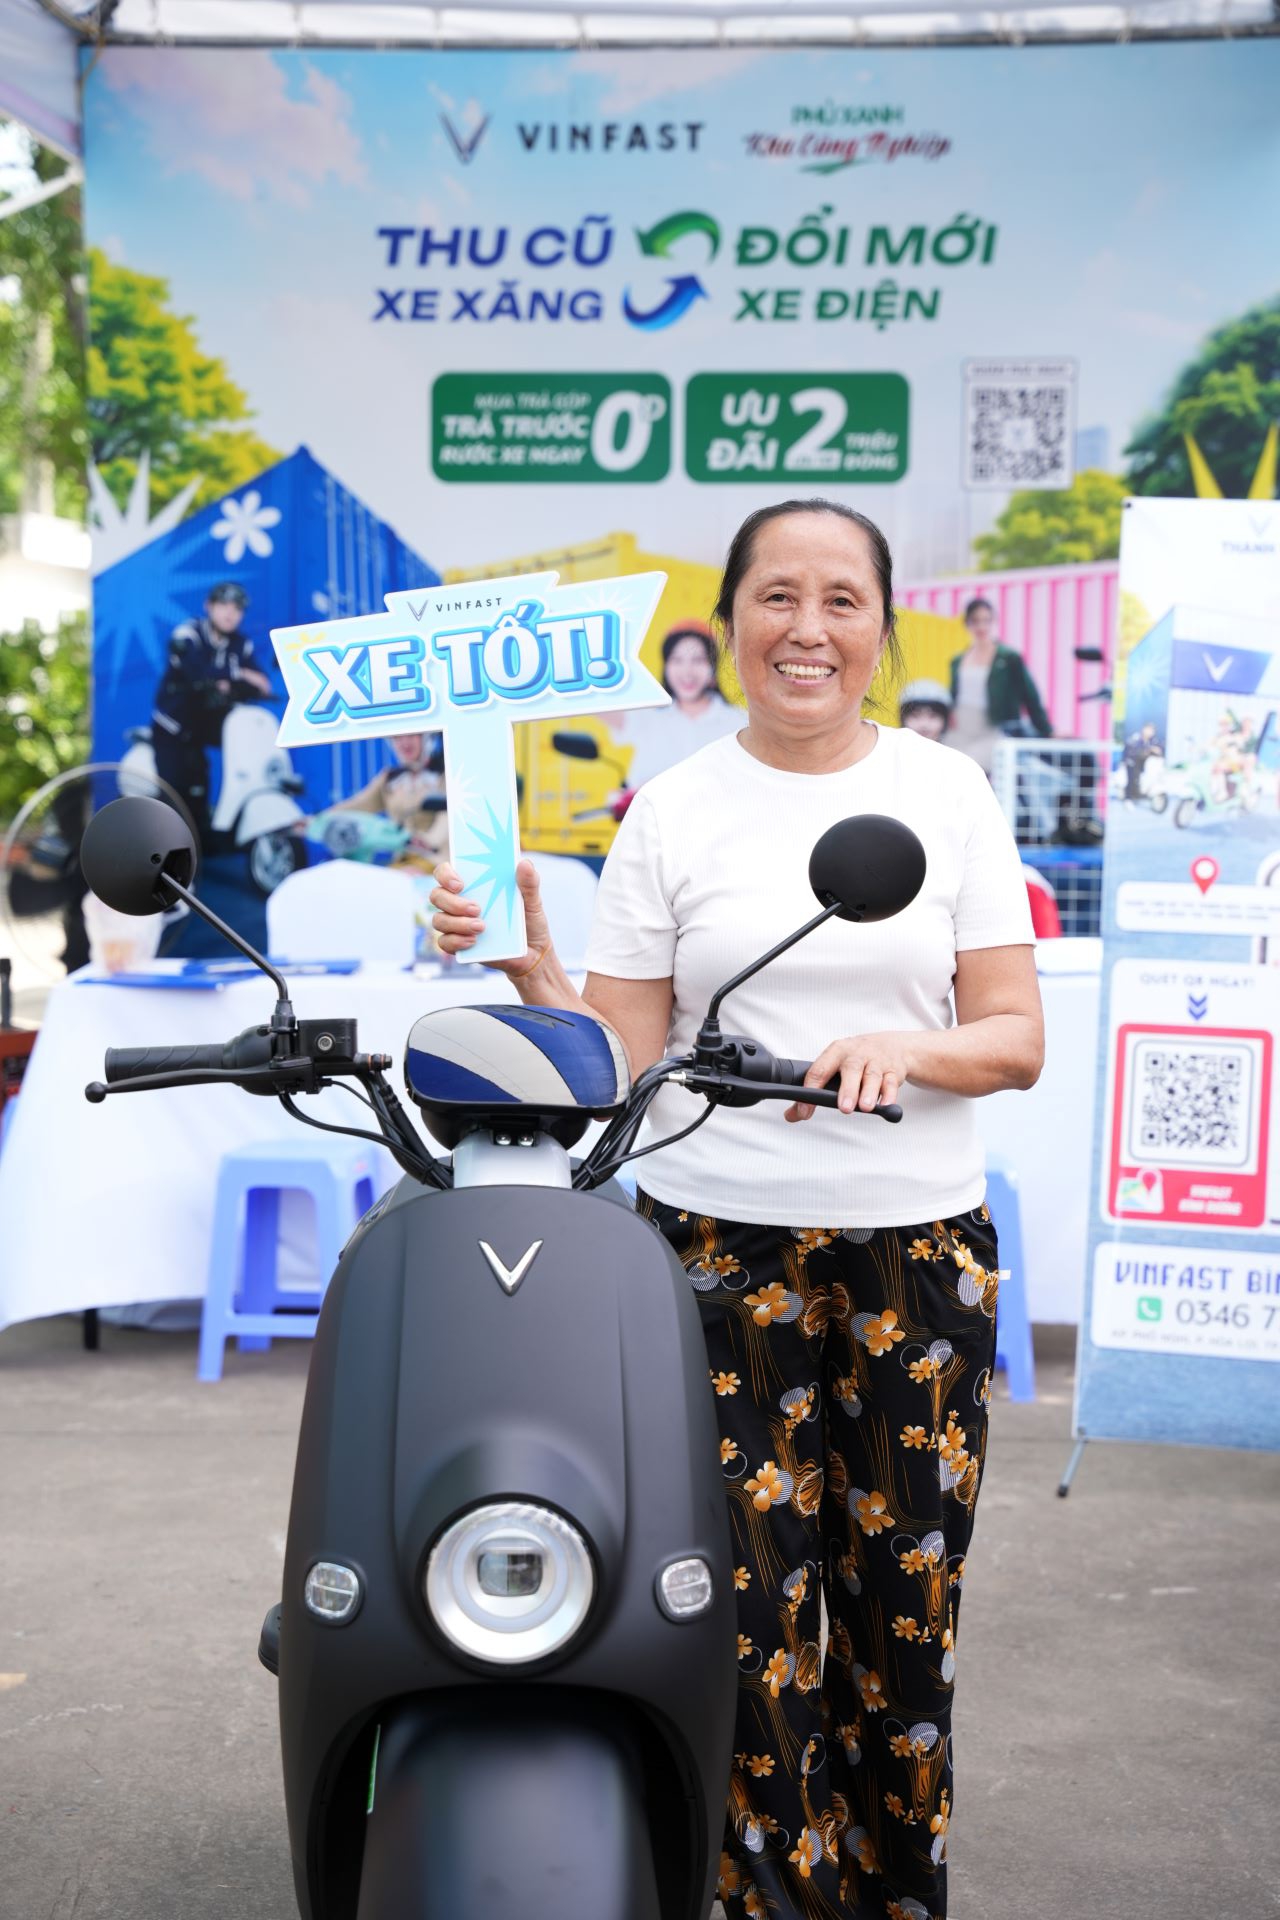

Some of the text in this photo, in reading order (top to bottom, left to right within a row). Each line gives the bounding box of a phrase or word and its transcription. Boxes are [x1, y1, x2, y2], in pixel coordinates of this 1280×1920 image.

[841, 105, 905, 125] XANH
[517, 122, 705, 153] VINFAST
[377, 214, 614, 267] THU CŨ
[736, 204, 997, 266] ĐỔI MỚI
[373, 279, 603, 321] XE XĂNG
[734, 279, 941, 331] XE ĐIỆN
[440, 410, 590, 440] TRẢ TRƯỚC
[721, 388, 781, 427] ƯU
[782, 386, 849, 471] 2
[498, 445, 528, 466] XE
[529, 445, 588, 466] NGAY
[706, 430, 780, 471] ĐÃI
[435, 597, 502, 613] VINFAST
[303, 600, 625, 724] XE TỐT!
[1115, 1260, 1234, 1291] VINFAST
[1175, 1299, 1250, 1329] 0346
